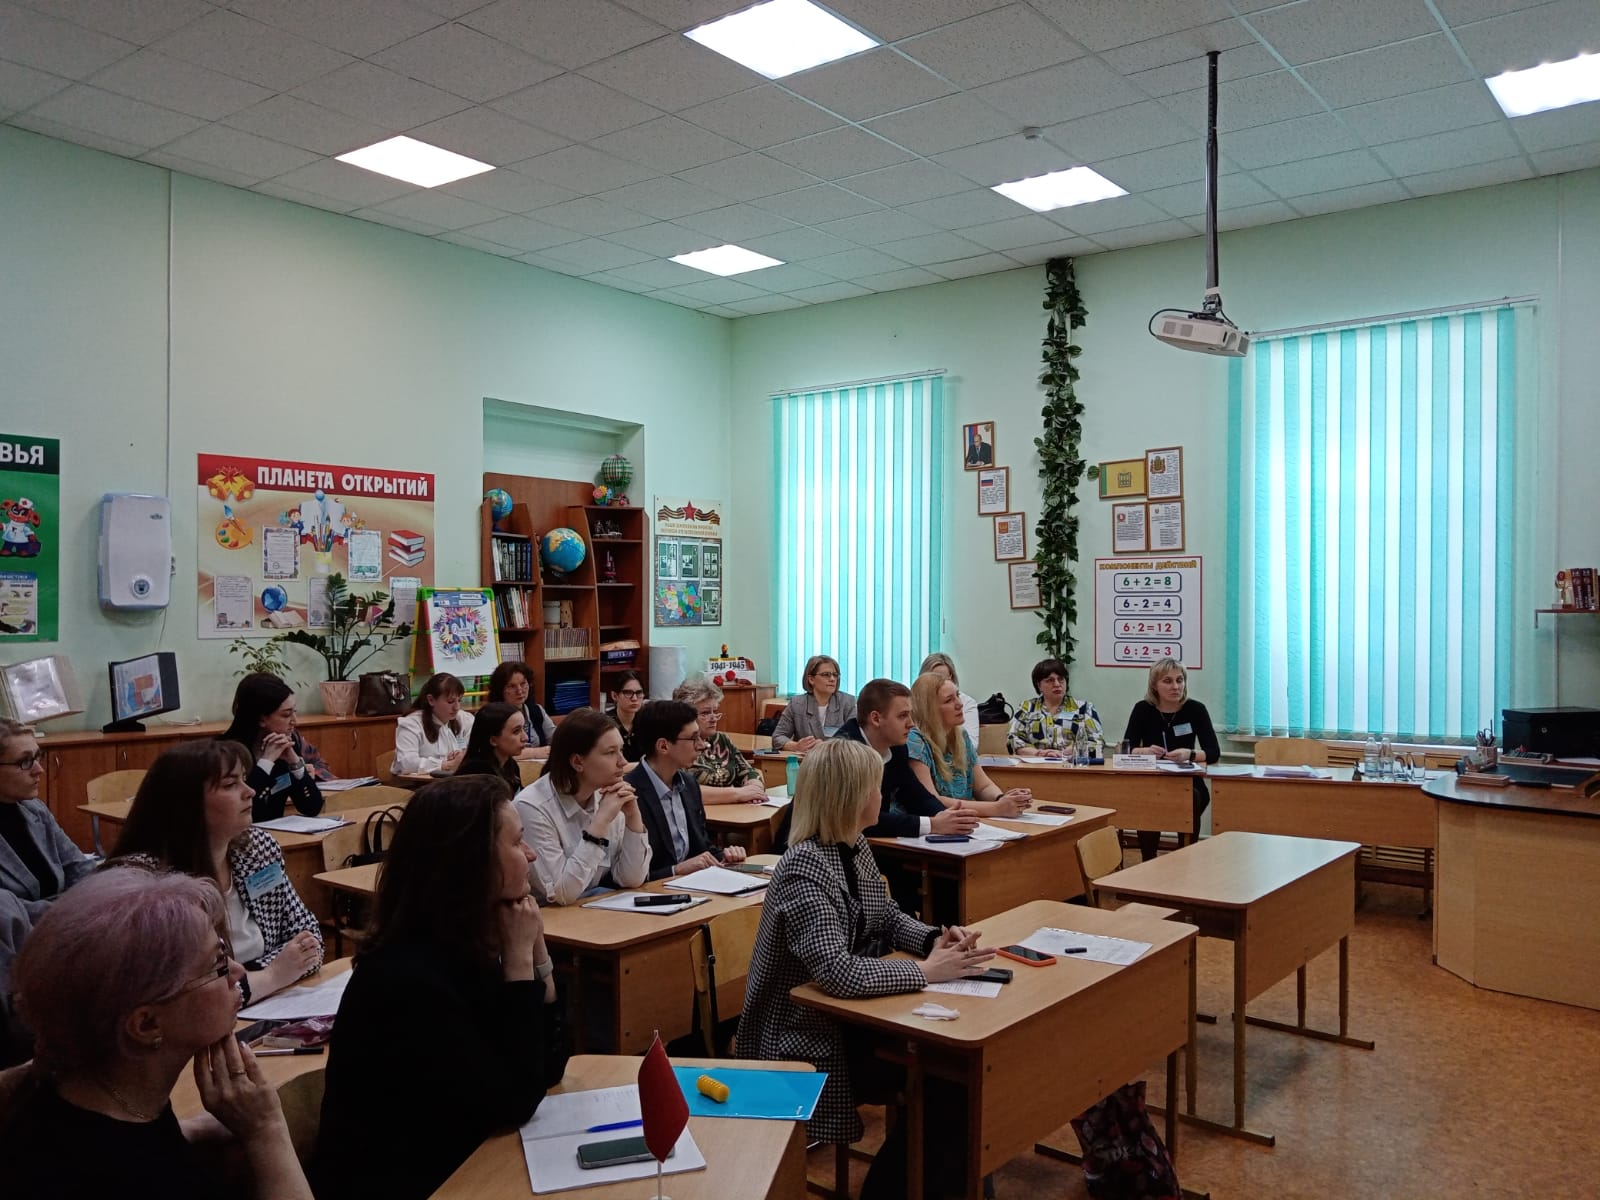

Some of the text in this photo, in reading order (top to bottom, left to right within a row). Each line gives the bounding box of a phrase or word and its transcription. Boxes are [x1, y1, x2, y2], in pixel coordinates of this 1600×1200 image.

[0, 441, 44, 465] ВЬЯ
[257, 466, 428, 496] ПЛАНЕТА ОТКРЫТИЙ
[1123, 577, 1130, 586] 6
[1144, 576, 1151, 586] 2
[1164, 576, 1172, 586] 8
[1123, 599, 1130, 608] 6
[1142, 599, 1149, 608] 2
[1164, 599, 1171, 608] 4
[1123, 622, 1130, 632] 6
[1138, 623, 1145, 632] 2
[1123, 646, 1130, 655] 6
[1142, 646, 1149, 655] 2
[1164, 646, 1172, 656] 3
[711, 660, 745, 670] 1941-1945
